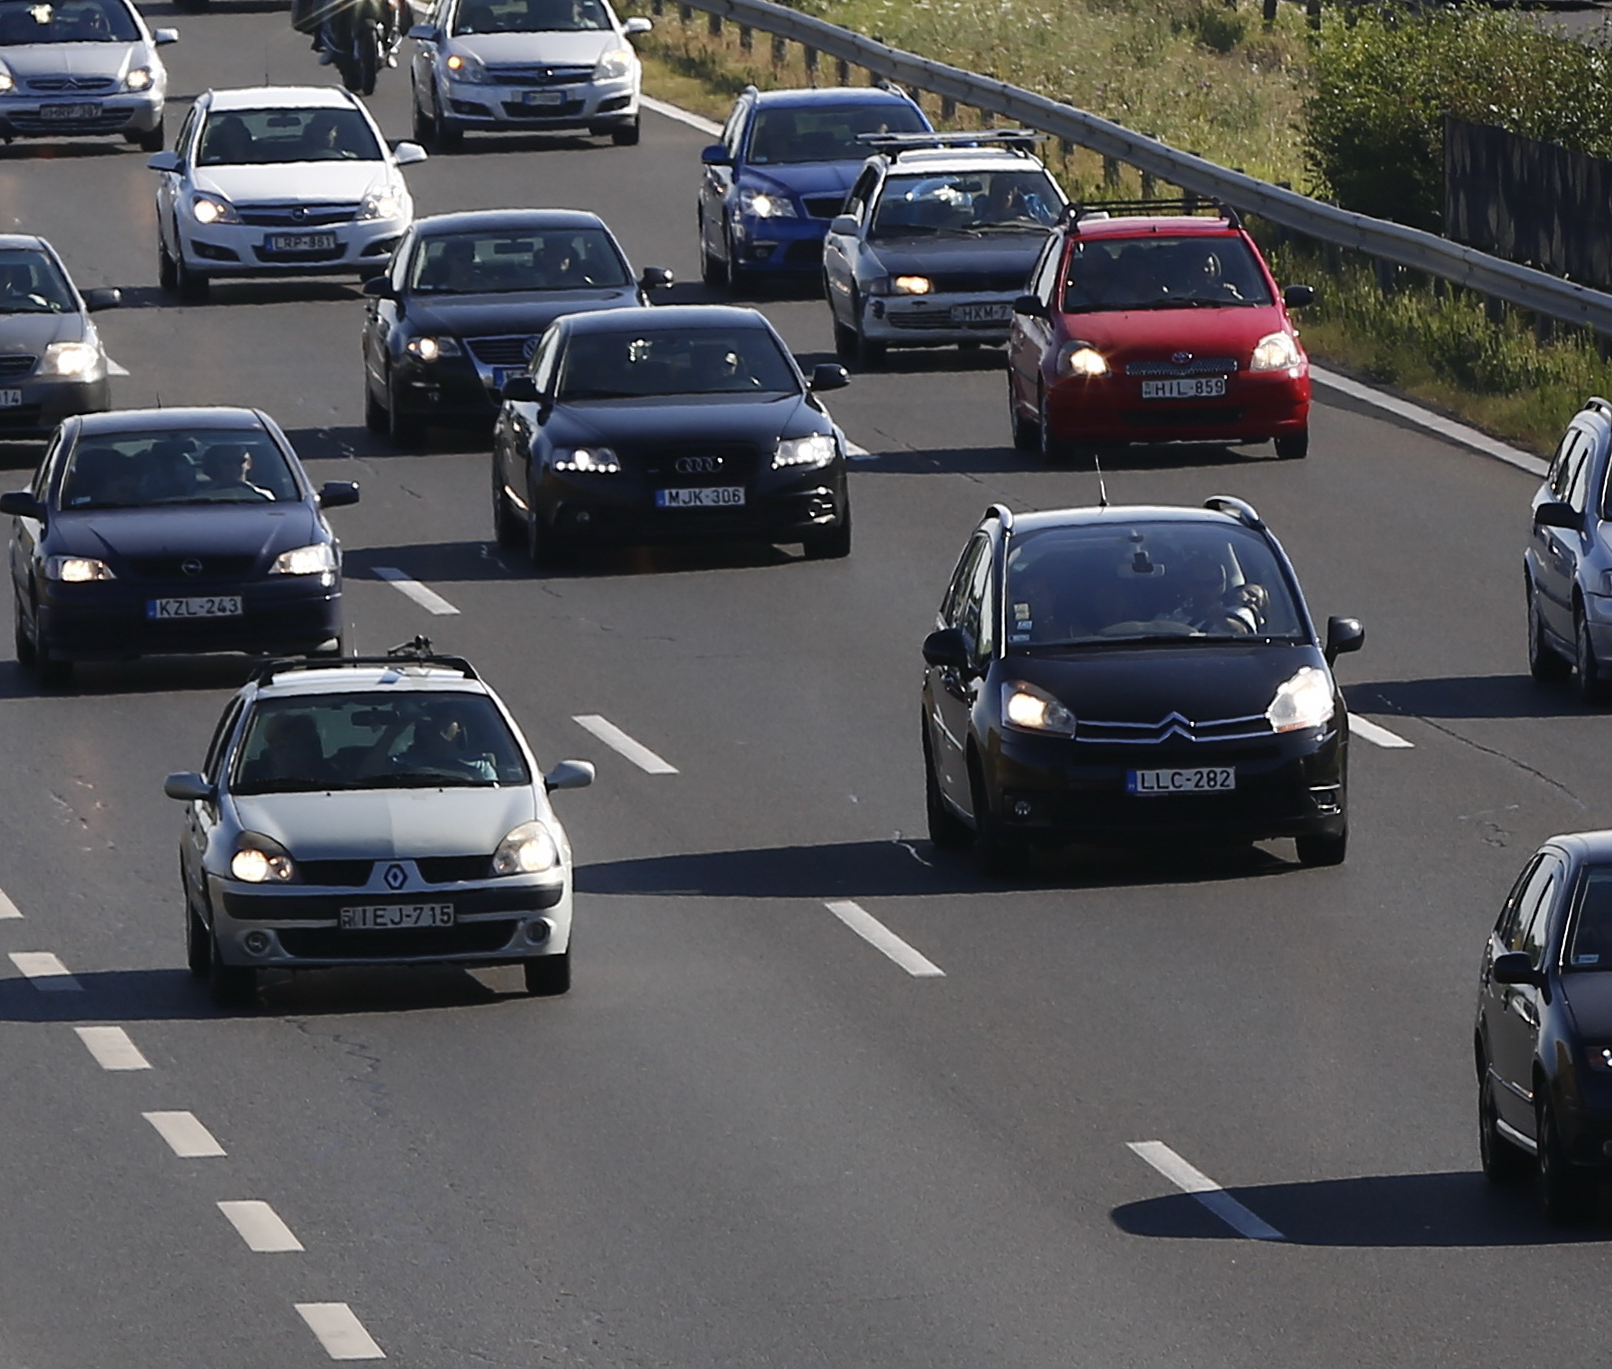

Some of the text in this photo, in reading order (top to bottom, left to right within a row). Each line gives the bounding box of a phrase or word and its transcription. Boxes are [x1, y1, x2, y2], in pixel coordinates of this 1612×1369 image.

[1155, 379, 1224, 396] HIL-859
[668, 488, 741, 505] MJK-306
[159, 597, 239, 617] KZL-243
[1141, 769, 1231, 790] LLC-282
[362, 905, 452, 927] IEJ-715
